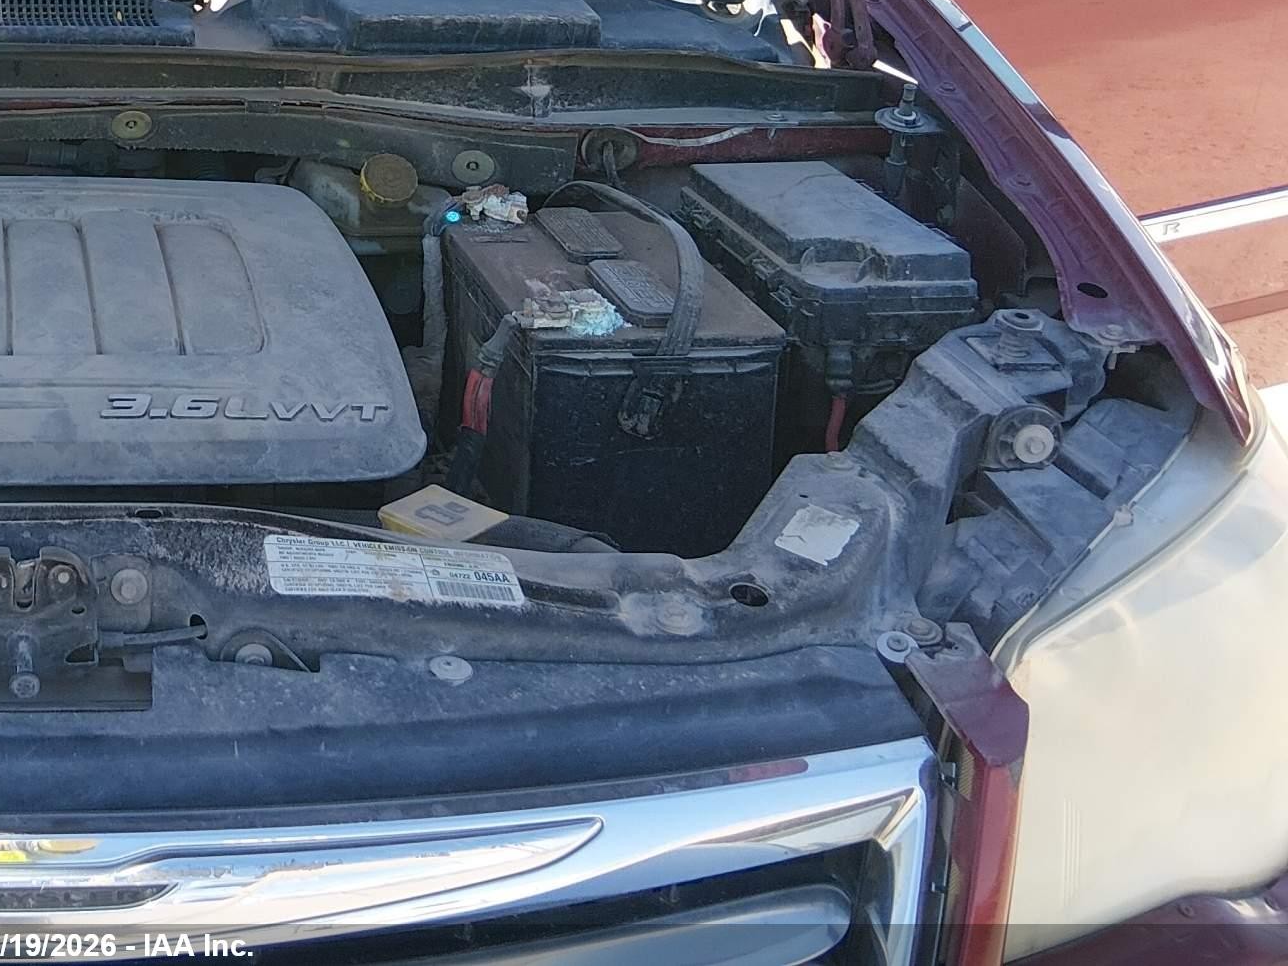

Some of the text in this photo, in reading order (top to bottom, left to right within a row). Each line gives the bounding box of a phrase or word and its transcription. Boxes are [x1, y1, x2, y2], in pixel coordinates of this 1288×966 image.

[270, 401, 389, 422] VVT
[276, 536, 306, 545] Chrysler
[308, 538, 330, 547] Group
[352, 541, 383, 550] VEHICLE
[383, 544, 418, 553] EMISSION
[473, 570, 510, 583] 045AA
